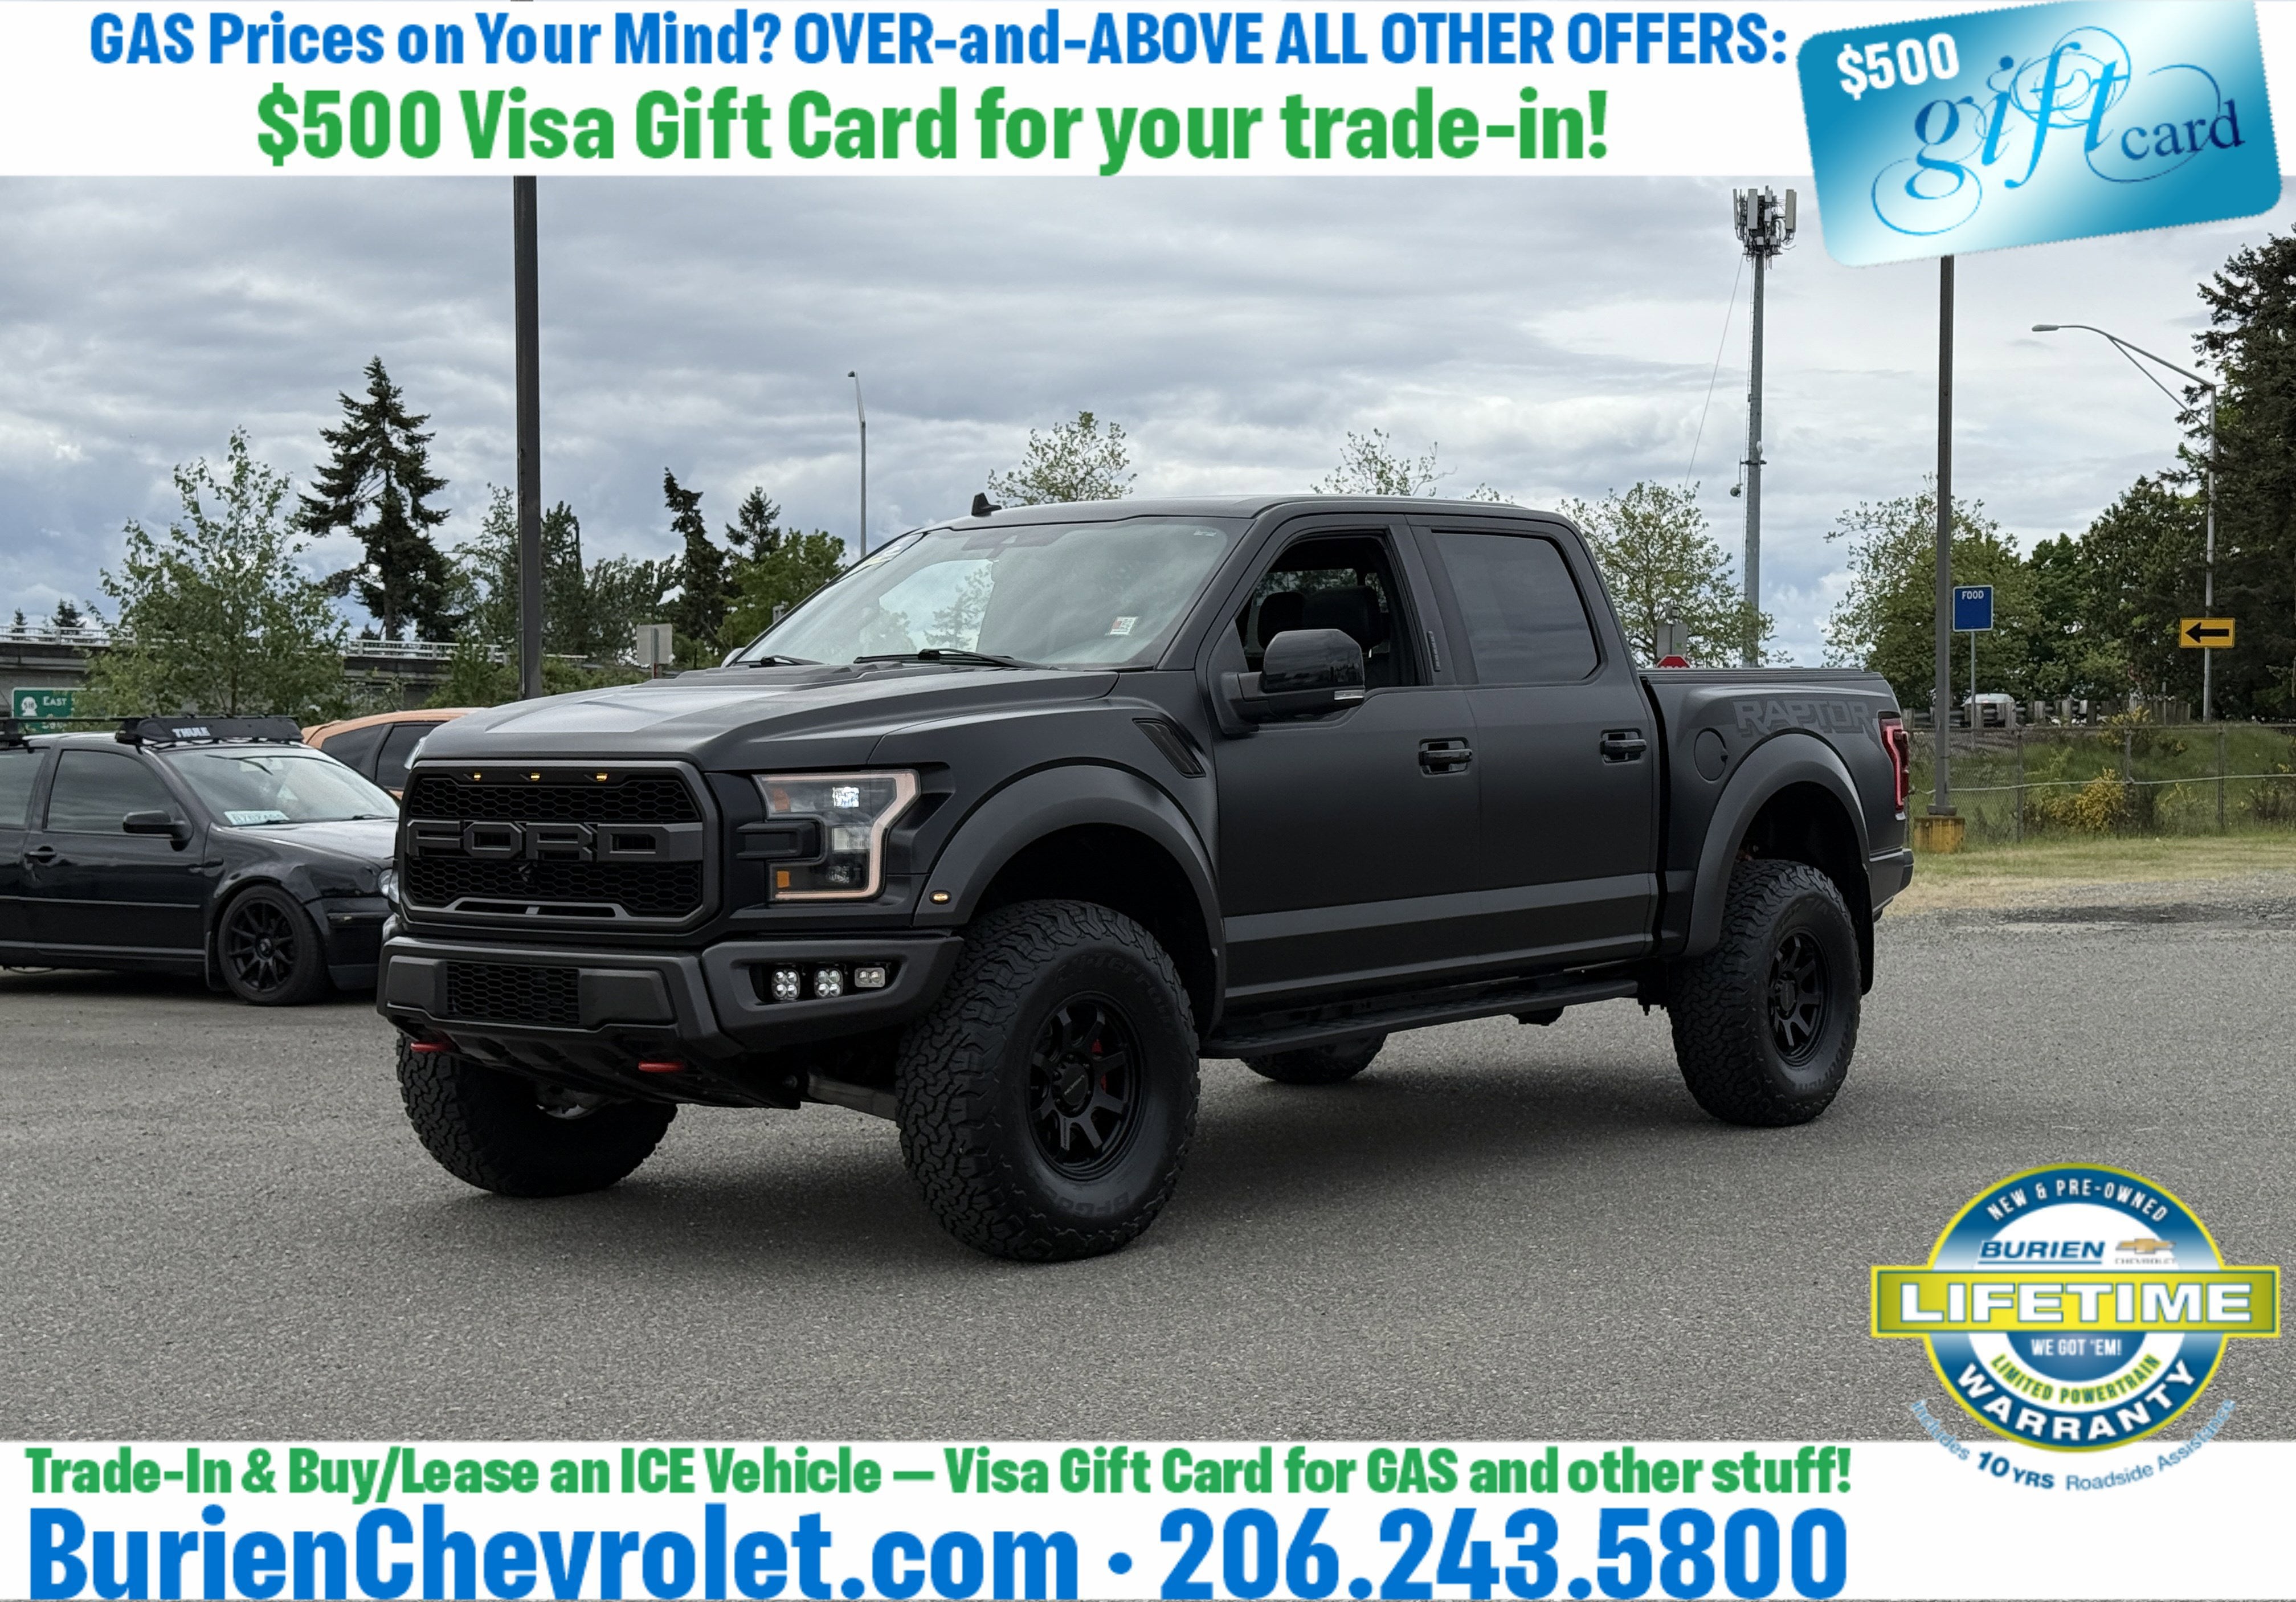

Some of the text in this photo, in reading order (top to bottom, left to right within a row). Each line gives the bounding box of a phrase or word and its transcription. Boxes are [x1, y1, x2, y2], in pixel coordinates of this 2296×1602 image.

[1962, 590, 1984, 600] FOOD
[172, 726, 211, 738] THULE
[1731, 699, 1879, 739] RAPTOR
[406, 819, 675, 862] FORD
